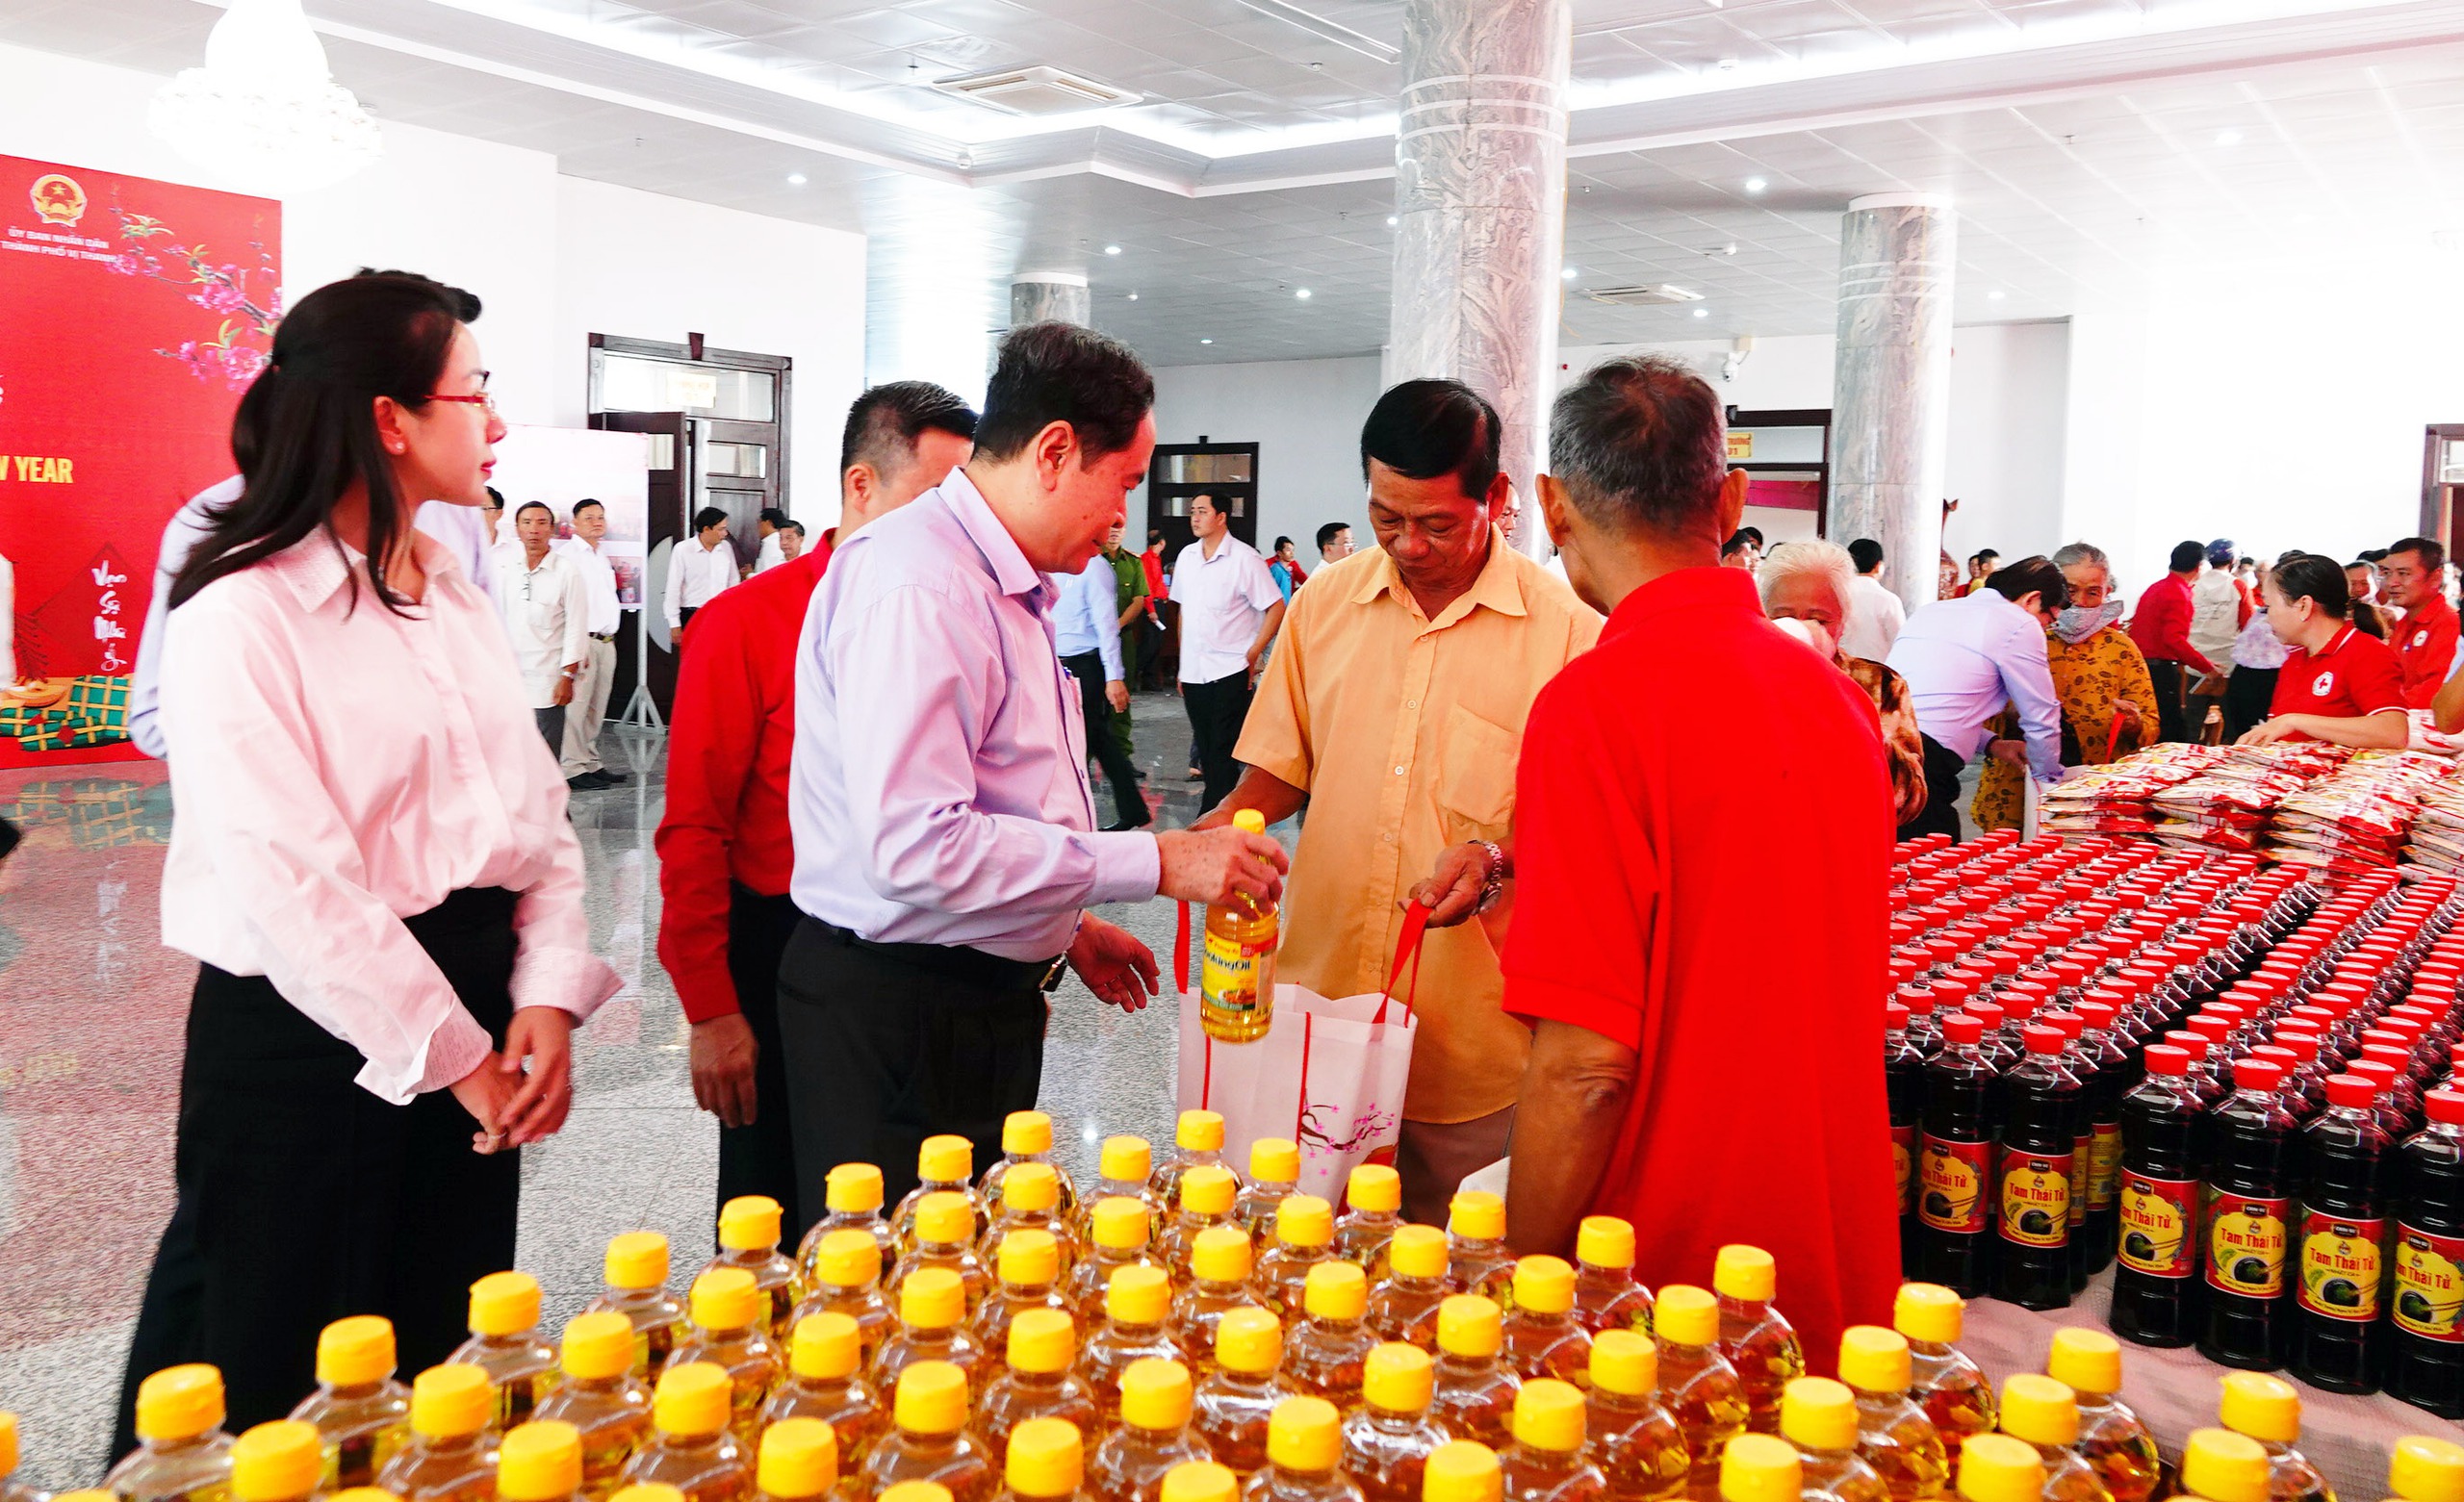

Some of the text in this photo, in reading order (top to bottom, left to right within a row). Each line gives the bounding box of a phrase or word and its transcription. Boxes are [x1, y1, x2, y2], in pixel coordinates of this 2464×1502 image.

[13, 455, 74, 483] YEAR
[2010, 1183, 2028, 1198] Tam
[2134, 1209, 2154, 1226] Thái
[2157, 1214, 2171, 1229] Tử
[2221, 1228, 2243, 1245] Tam
[2310, 1247, 2331, 1265] Tam
[2435, 1274, 2451, 1289] Tử
